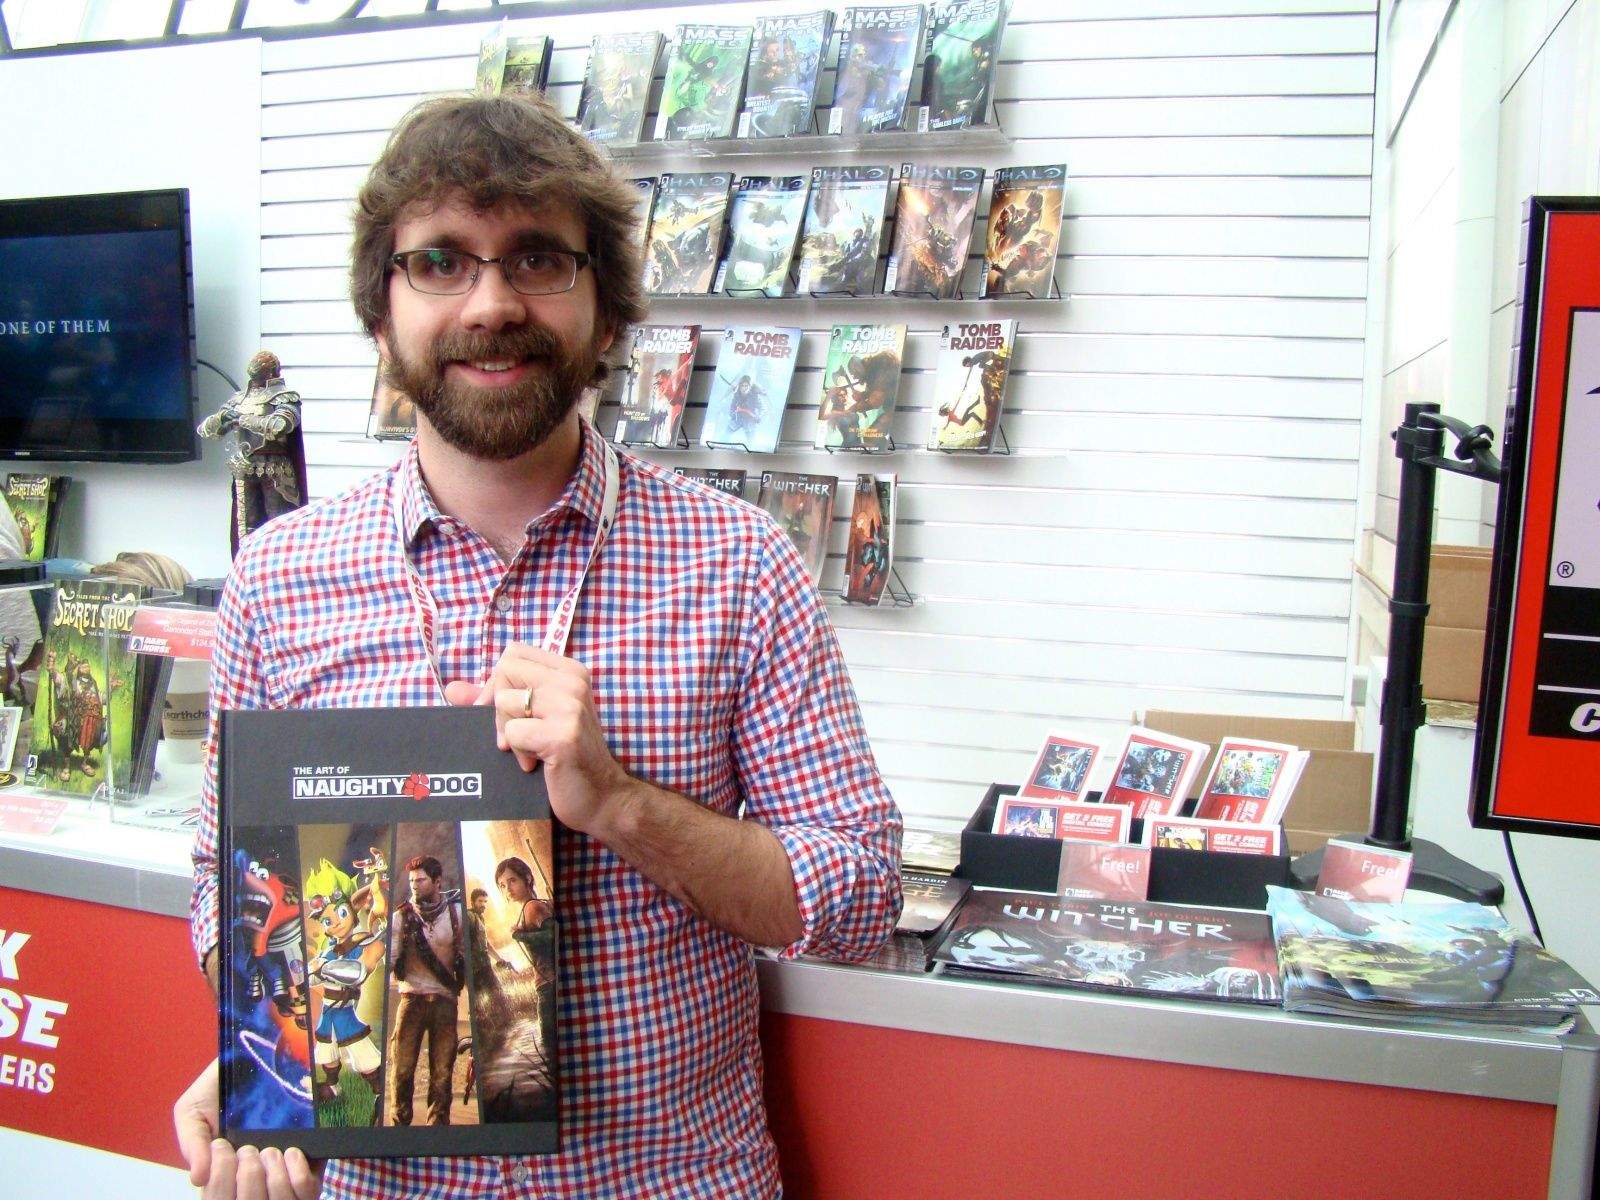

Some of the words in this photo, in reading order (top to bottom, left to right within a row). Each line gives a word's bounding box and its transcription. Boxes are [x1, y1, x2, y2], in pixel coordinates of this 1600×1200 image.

[855, 9, 918, 23] MASS
[937, 1, 999, 18] MASS
[766, 15, 824, 31] MASS
[684, 29, 748, 40] MASS
[823, 168, 884, 180] HALO
[912, 166, 978, 180] HALO
[1001, 168, 1062, 180] HALO
[671, 176, 726, 188] HALO
[750, 178, 804, 191] HALO
[0, 321, 30, 335] ONE
[36, 320, 56, 334] OF
[61, 319, 111, 334] THEM
[850, 327, 896, 341] TOMB
[958, 323, 1002, 337] TOMB
[651, 328, 692, 342] TOMB
[743, 330, 790, 345] TOMB
[643, 340, 693, 354] RAIDER
[734, 342, 793, 358] RAIDER
[842, 339, 898, 355] RAIDER
[950, 336, 1005, 350] RAIDER
[773, 481, 832, 496] WITCHER
[54, 588, 100, 636] SECRET
[293, 767, 312, 775] THE
[315, 766, 335, 775] ART
[337, 766, 350, 774] OF
[296, 776, 406, 797] NAUGHTY
[430, 776, 479, 794] DOG
[1101, 856, 1140, 874] Free!
[911, 876, 948, 884] HARDIN
[1100, 904, 1136, 916] THE
[1003, 904, 1232, 942] WITCHER
